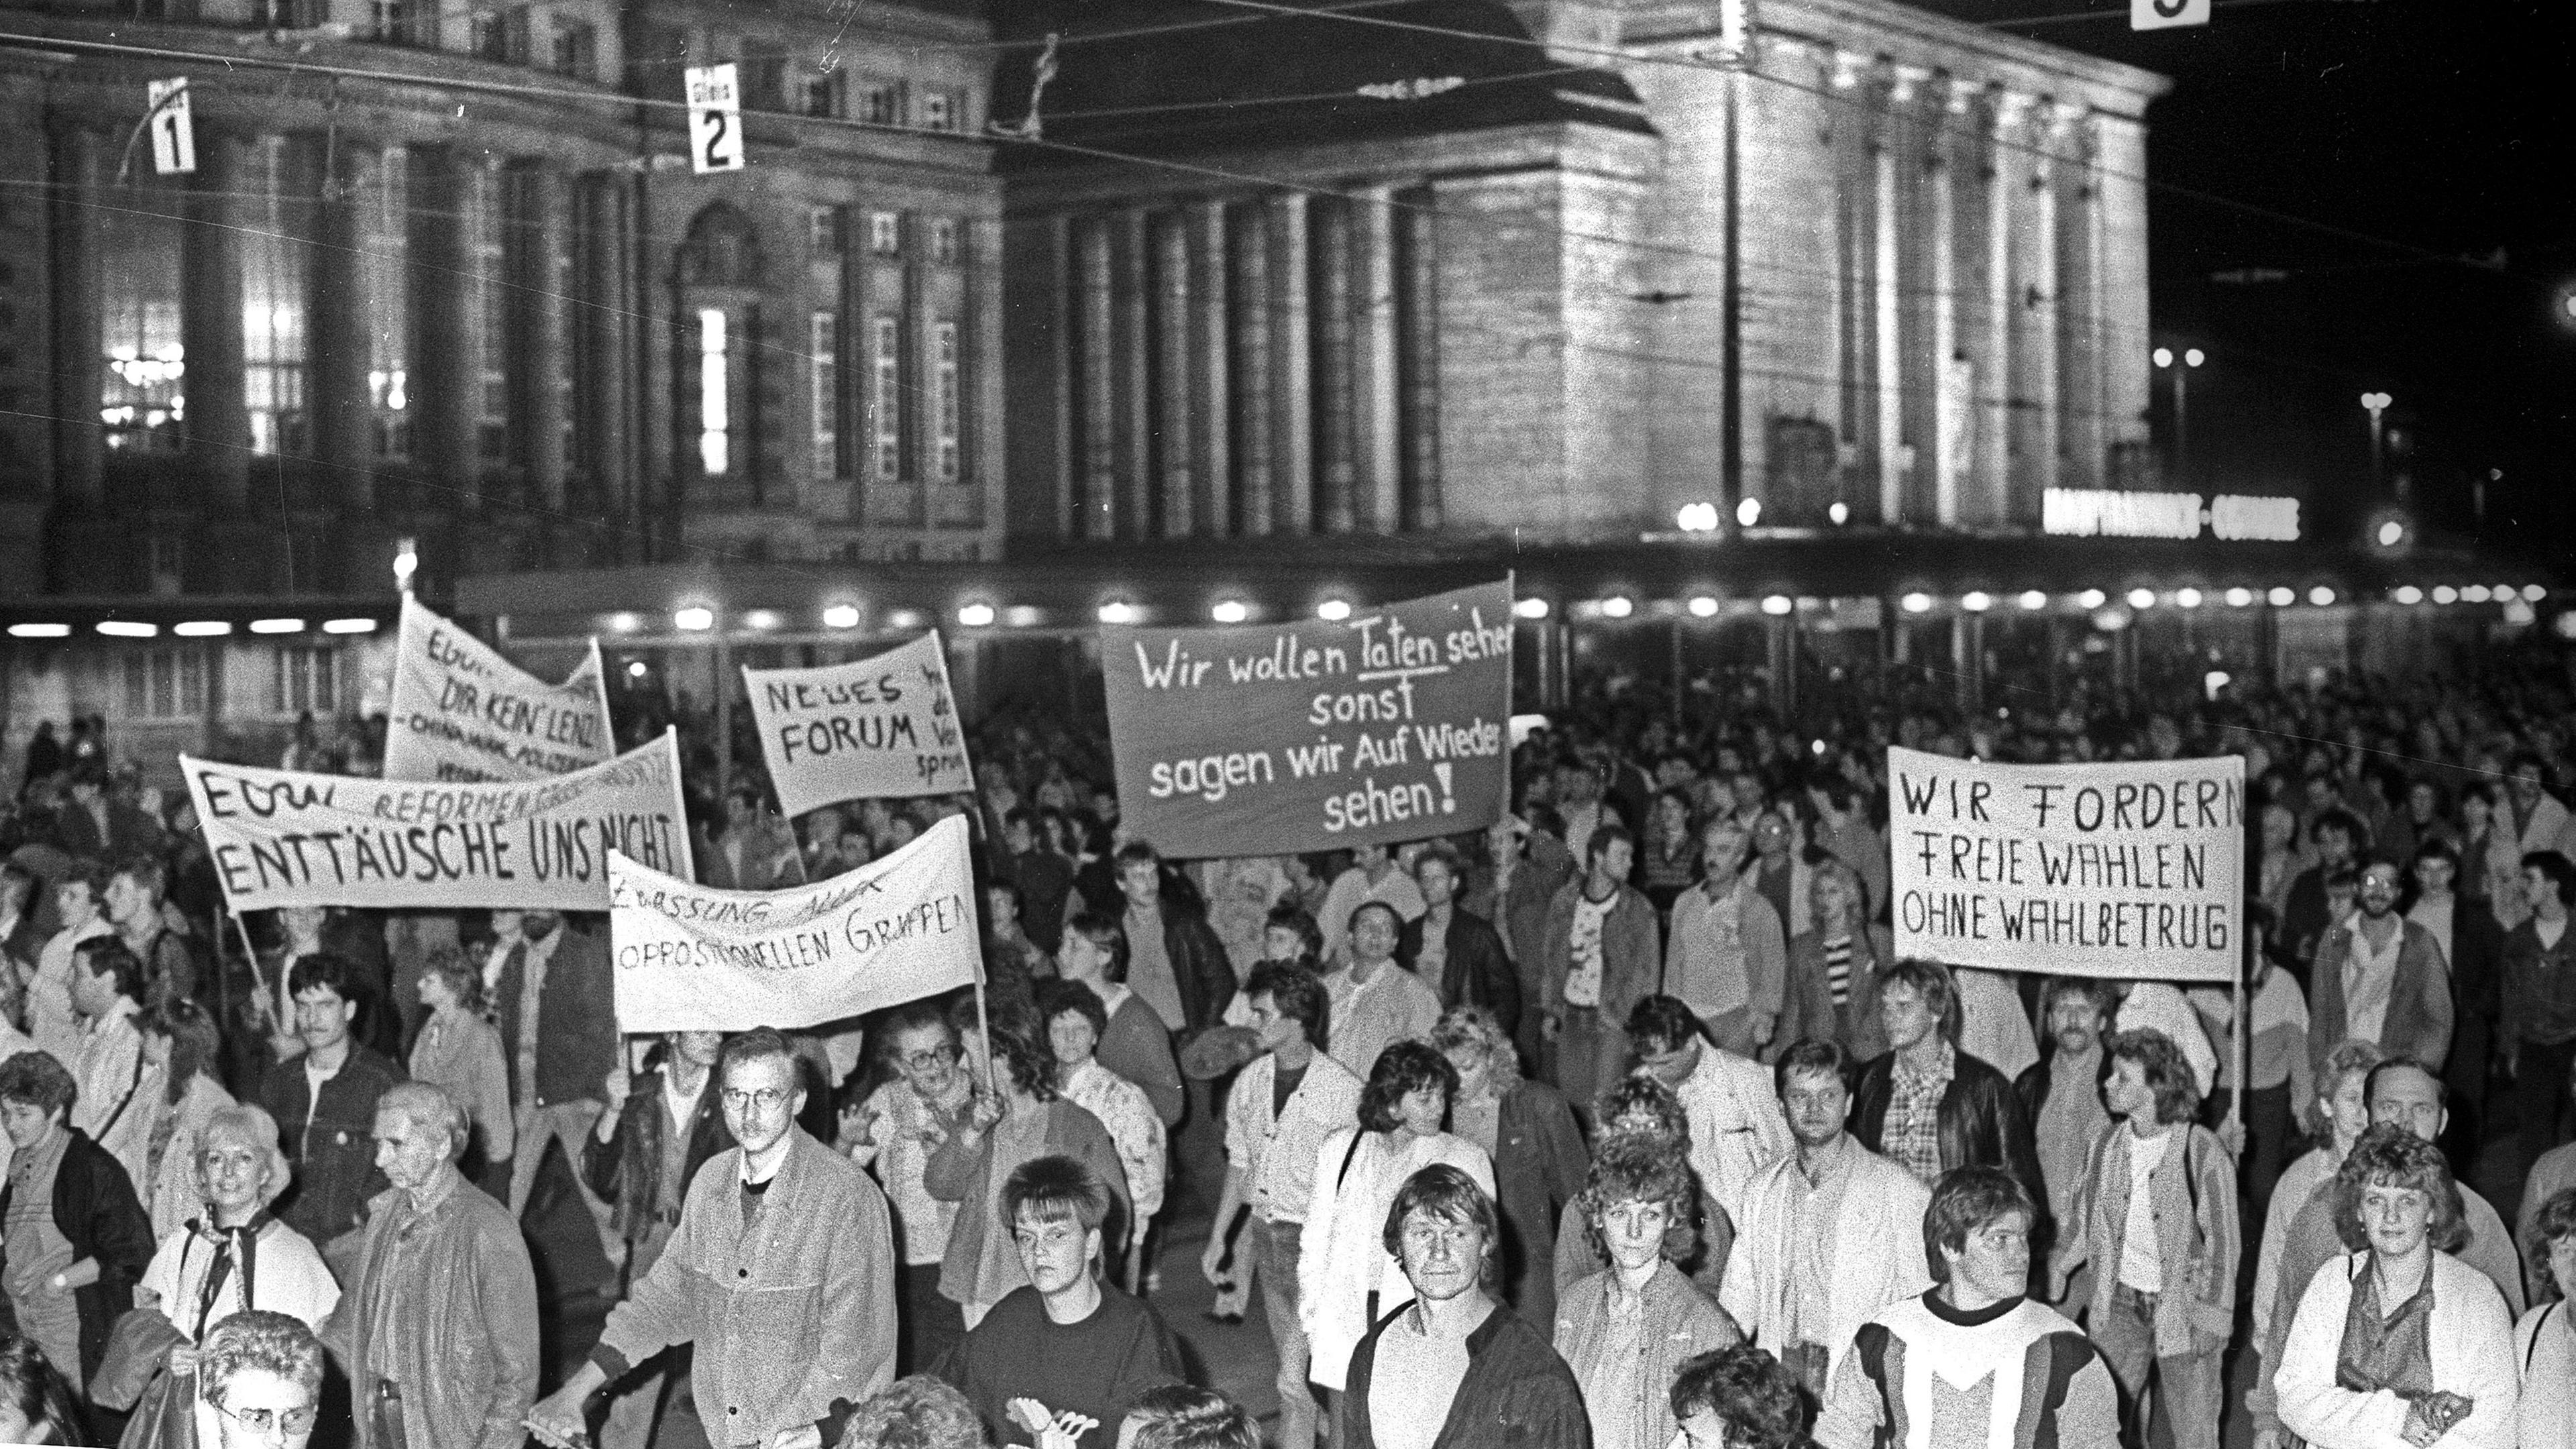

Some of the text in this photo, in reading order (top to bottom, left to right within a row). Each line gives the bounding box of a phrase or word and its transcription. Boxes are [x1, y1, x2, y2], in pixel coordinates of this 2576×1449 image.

[165, 114, 181, 168] 1
[704, 109, 730, 168] 2
[1136, 638, 1213, 690] Wir
[1229, 634, 1347, 684] wollen
[1349, 616, 1438, 667] Taten
[440, 675, 479, 718] DIR
[767, 674, 903, 713] NEUES
[1309, 674, 1414, 726] sonst
[781, 714, 918, 763] FORUM
[1150, 749, 1274, 802] sagen
[1286, 737, 1344, 777] wir
[1353, 725, 1410, 769] Auf
[1324, 762, 1456, 833] sehen!
[1899, 772, 2245, 833] WIR FORDERN
[216, 820, 516, 896] ENTTÄUSCHE
[530, 818, 592, 883] UNS
[1912, 830, 2205, 890] FREIE WAHLEN
[1902, 890, 2229, 950] OHNE WAHLBETRUG
